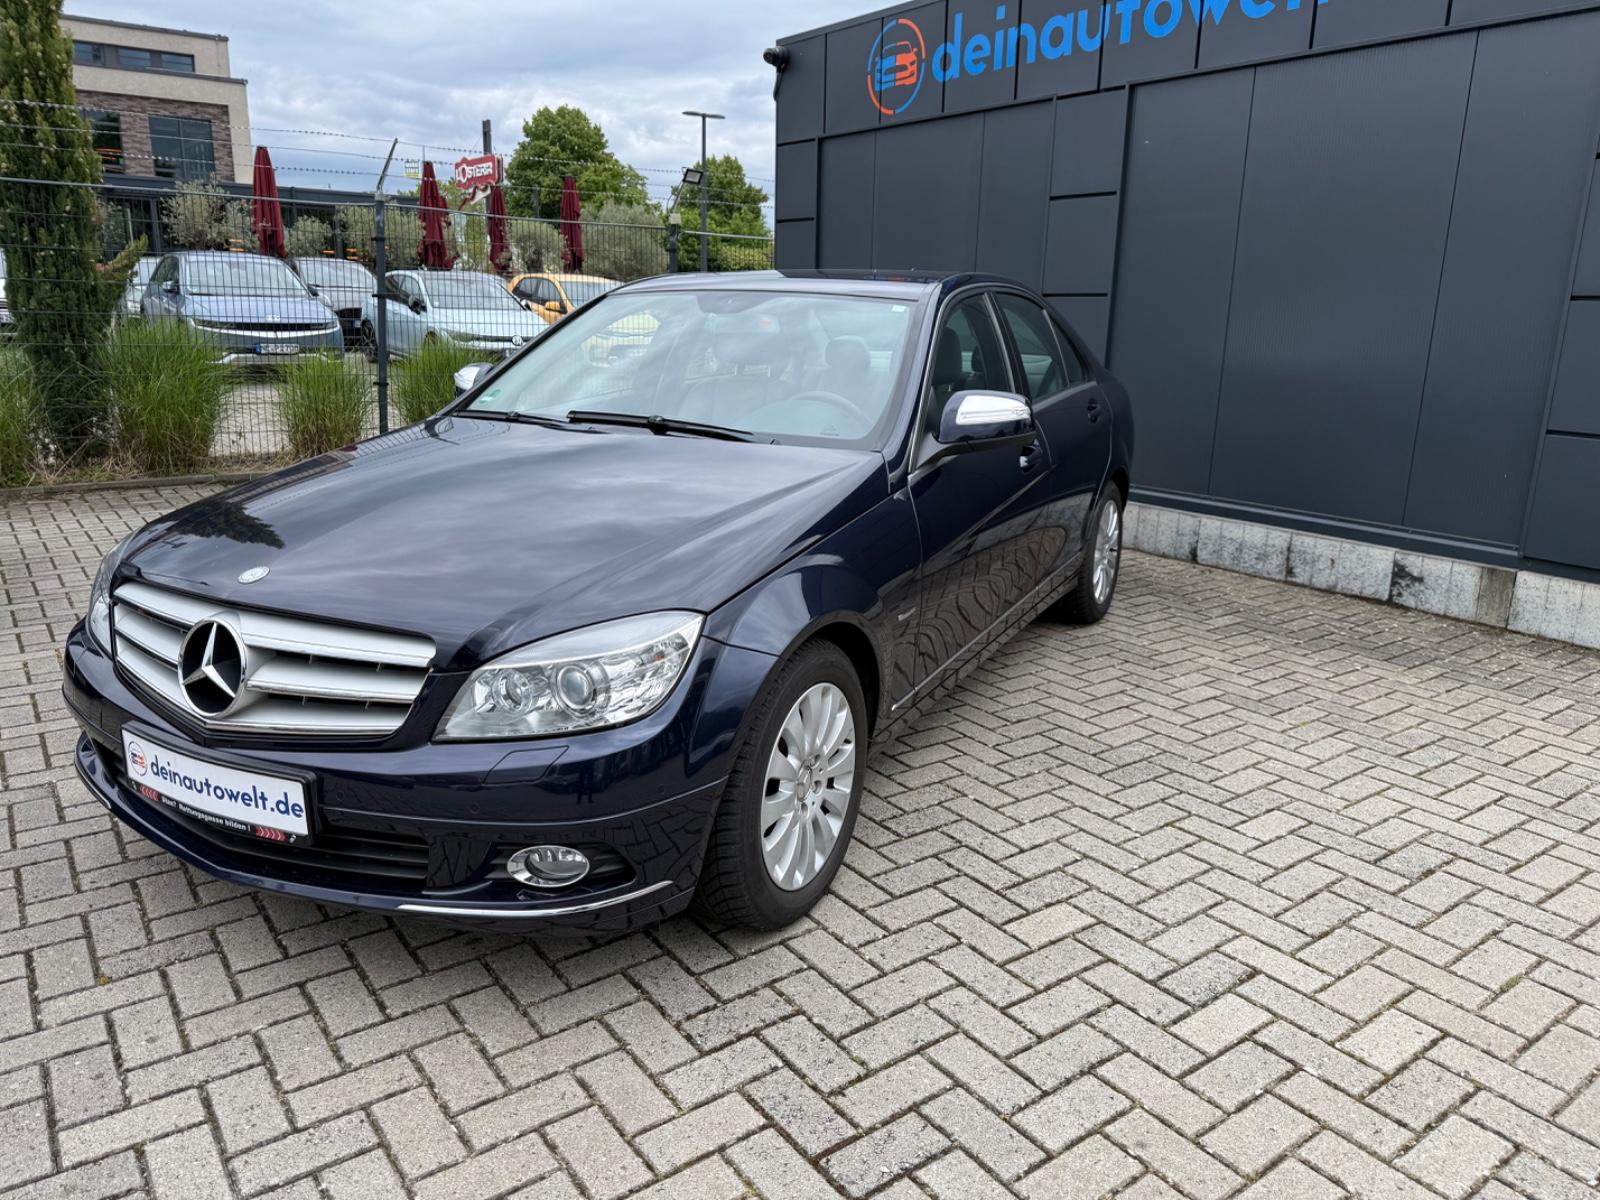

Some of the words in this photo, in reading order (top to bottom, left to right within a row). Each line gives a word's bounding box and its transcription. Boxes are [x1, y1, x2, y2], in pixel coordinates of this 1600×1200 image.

[931, 0, 1329, 83] deinautow
[150, 755, 304, 818] deinautowelt.de
[224, 818, 247, 831] bilden
